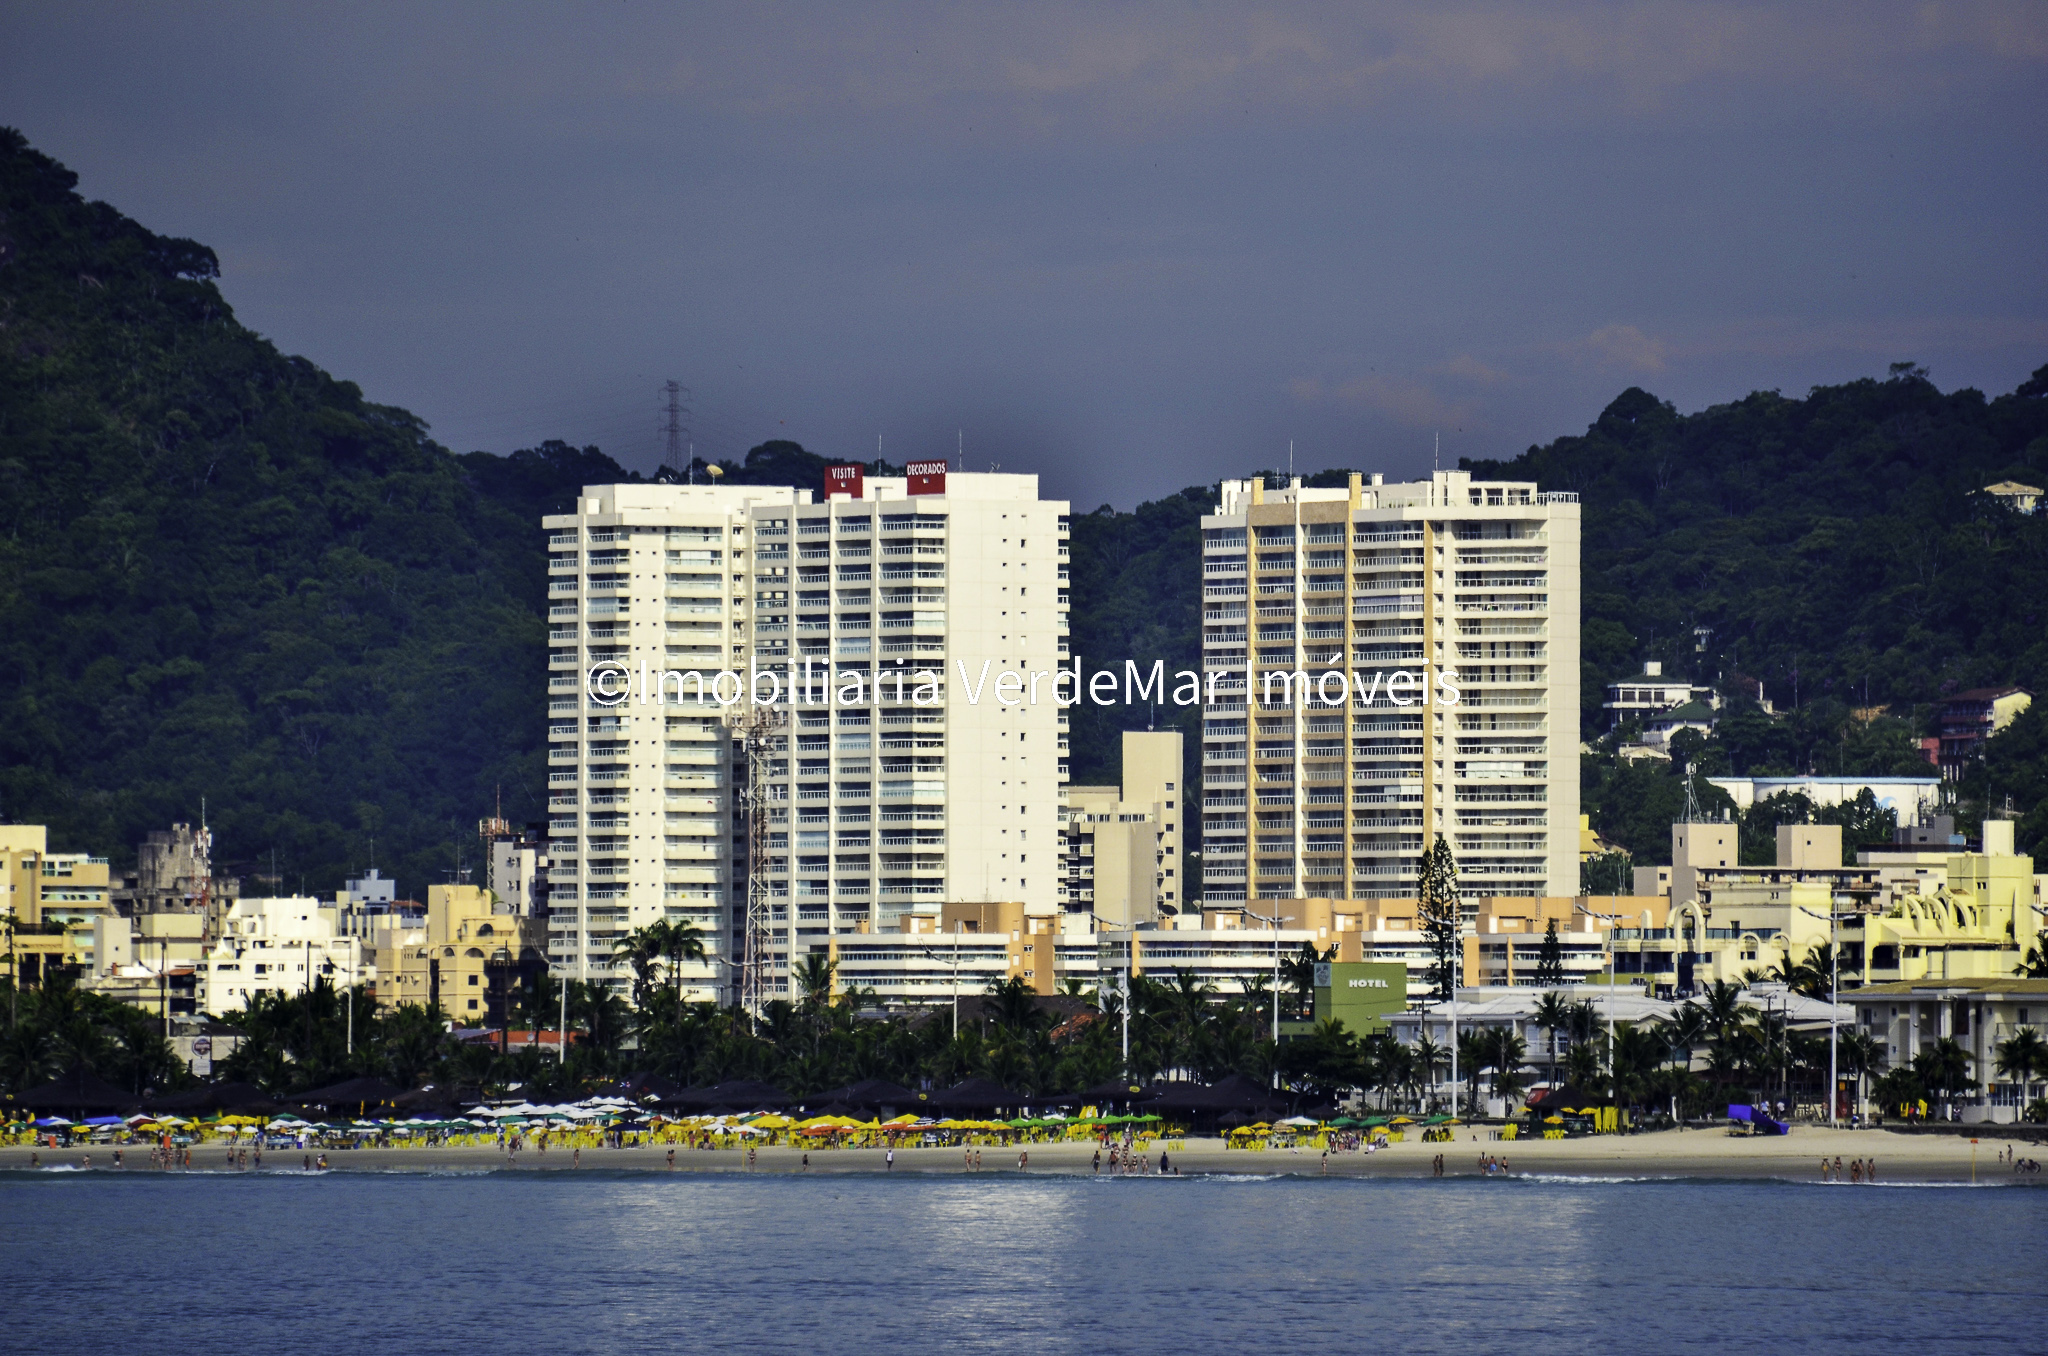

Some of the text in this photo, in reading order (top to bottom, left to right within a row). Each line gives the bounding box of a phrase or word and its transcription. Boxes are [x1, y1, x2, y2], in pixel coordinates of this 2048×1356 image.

[831, 467, 856, 480] VISITE
[907, 463, 946, 476] DECORADOS
[1348, 979, 1389, 988] HOTEL
